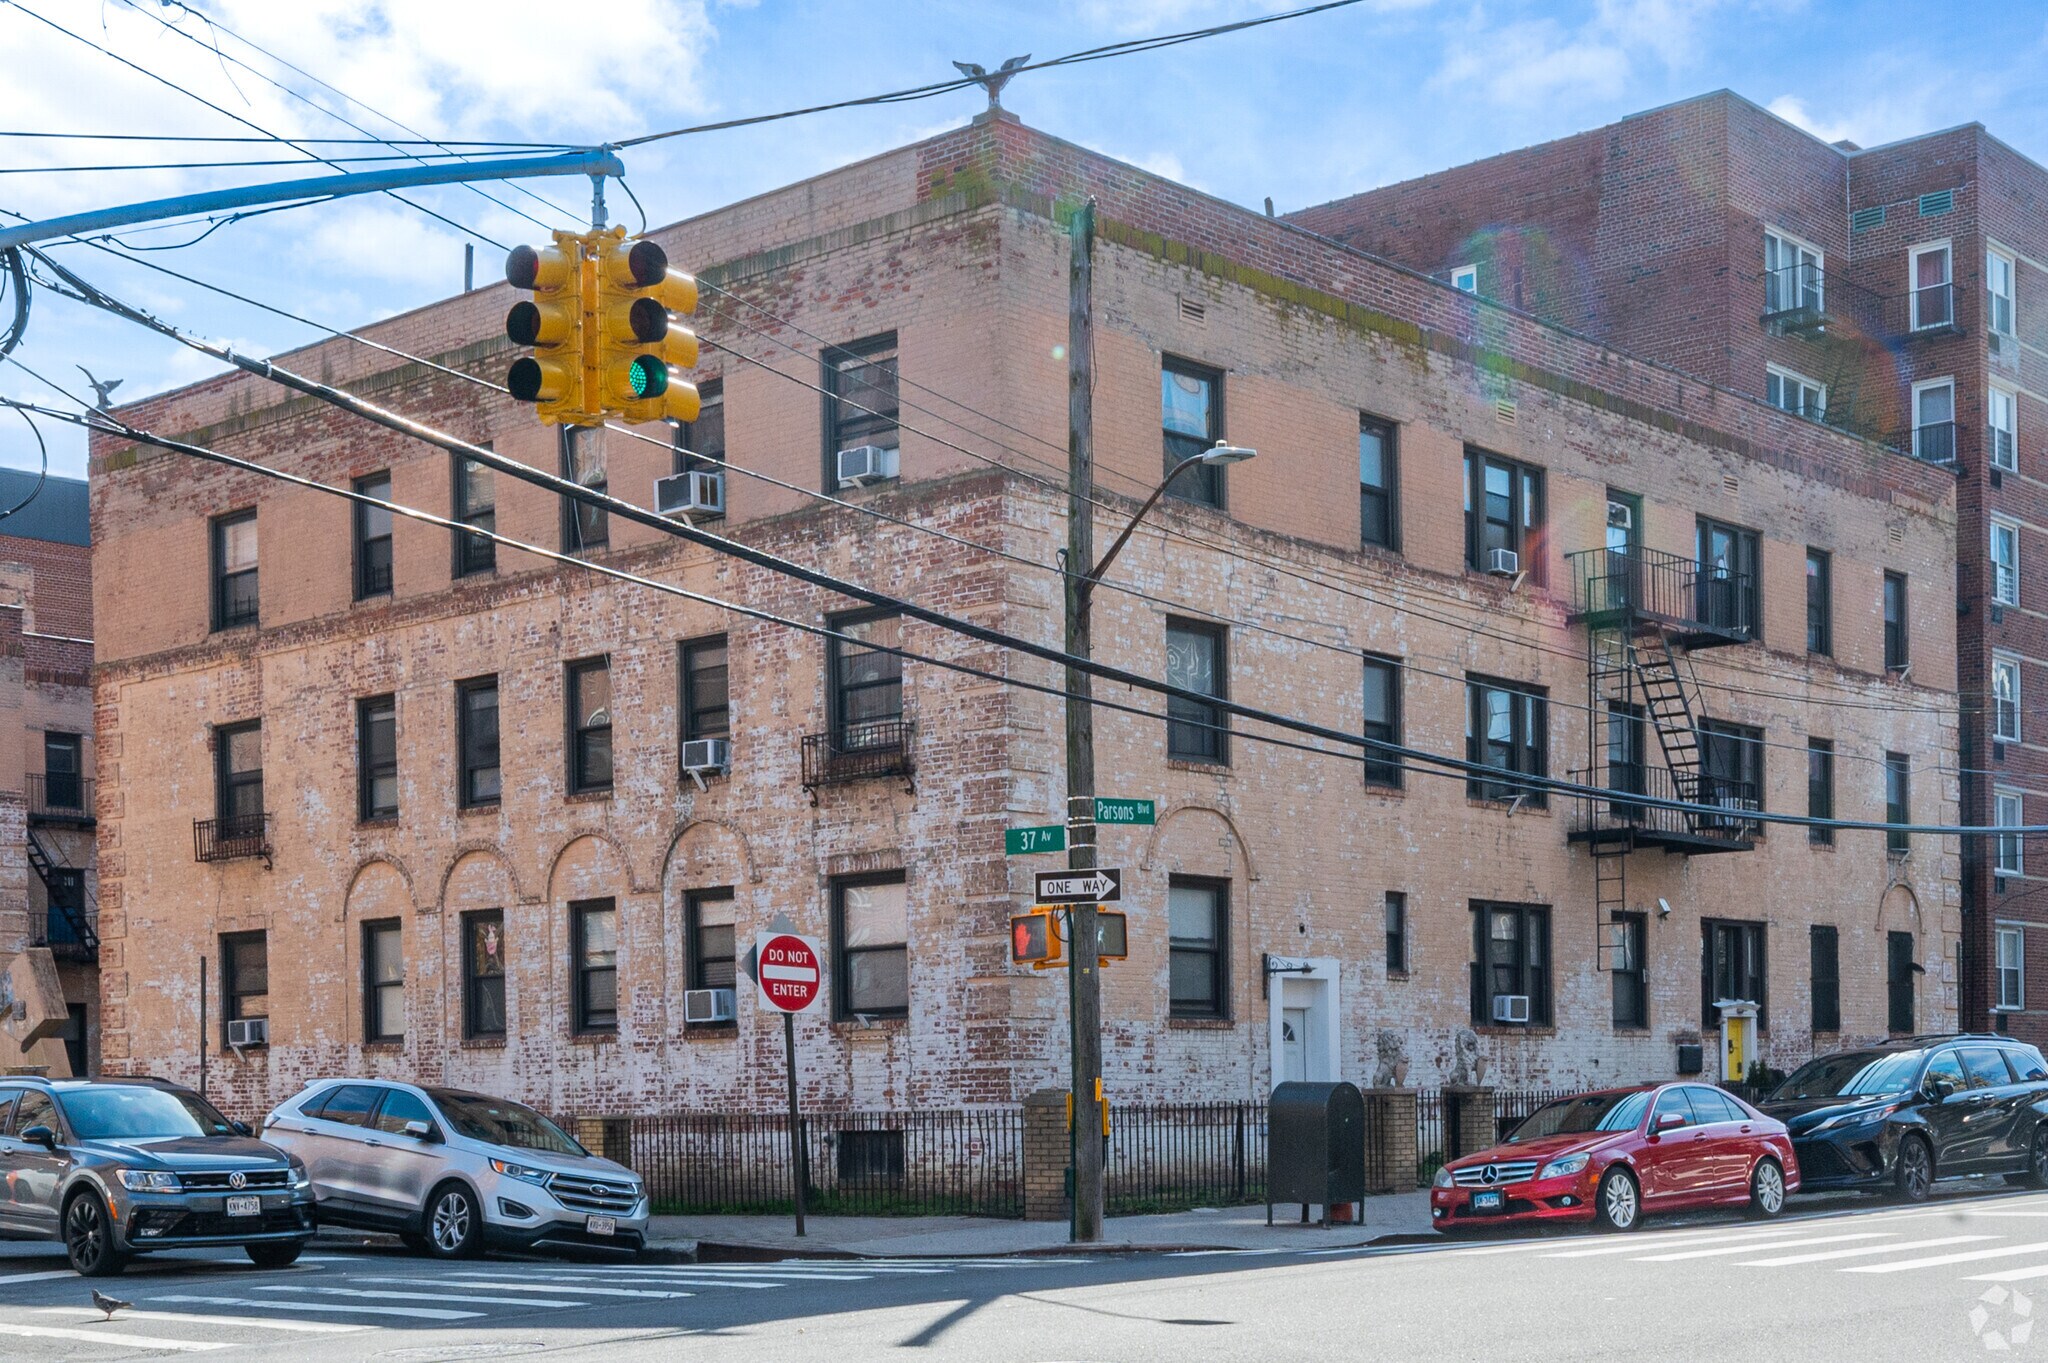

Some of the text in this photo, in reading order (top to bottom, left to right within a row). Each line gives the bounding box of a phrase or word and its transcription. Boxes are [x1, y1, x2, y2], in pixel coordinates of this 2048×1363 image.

[1097, 801, 1150, 820] Parsons Blvd
[1020, 831, 1051, 850] 37 Av
[1047, 879, 1108, 895] ONE WAY
[769, 948, 809, 964] DO NOT
[772, 983, 808, 998] ENTER
